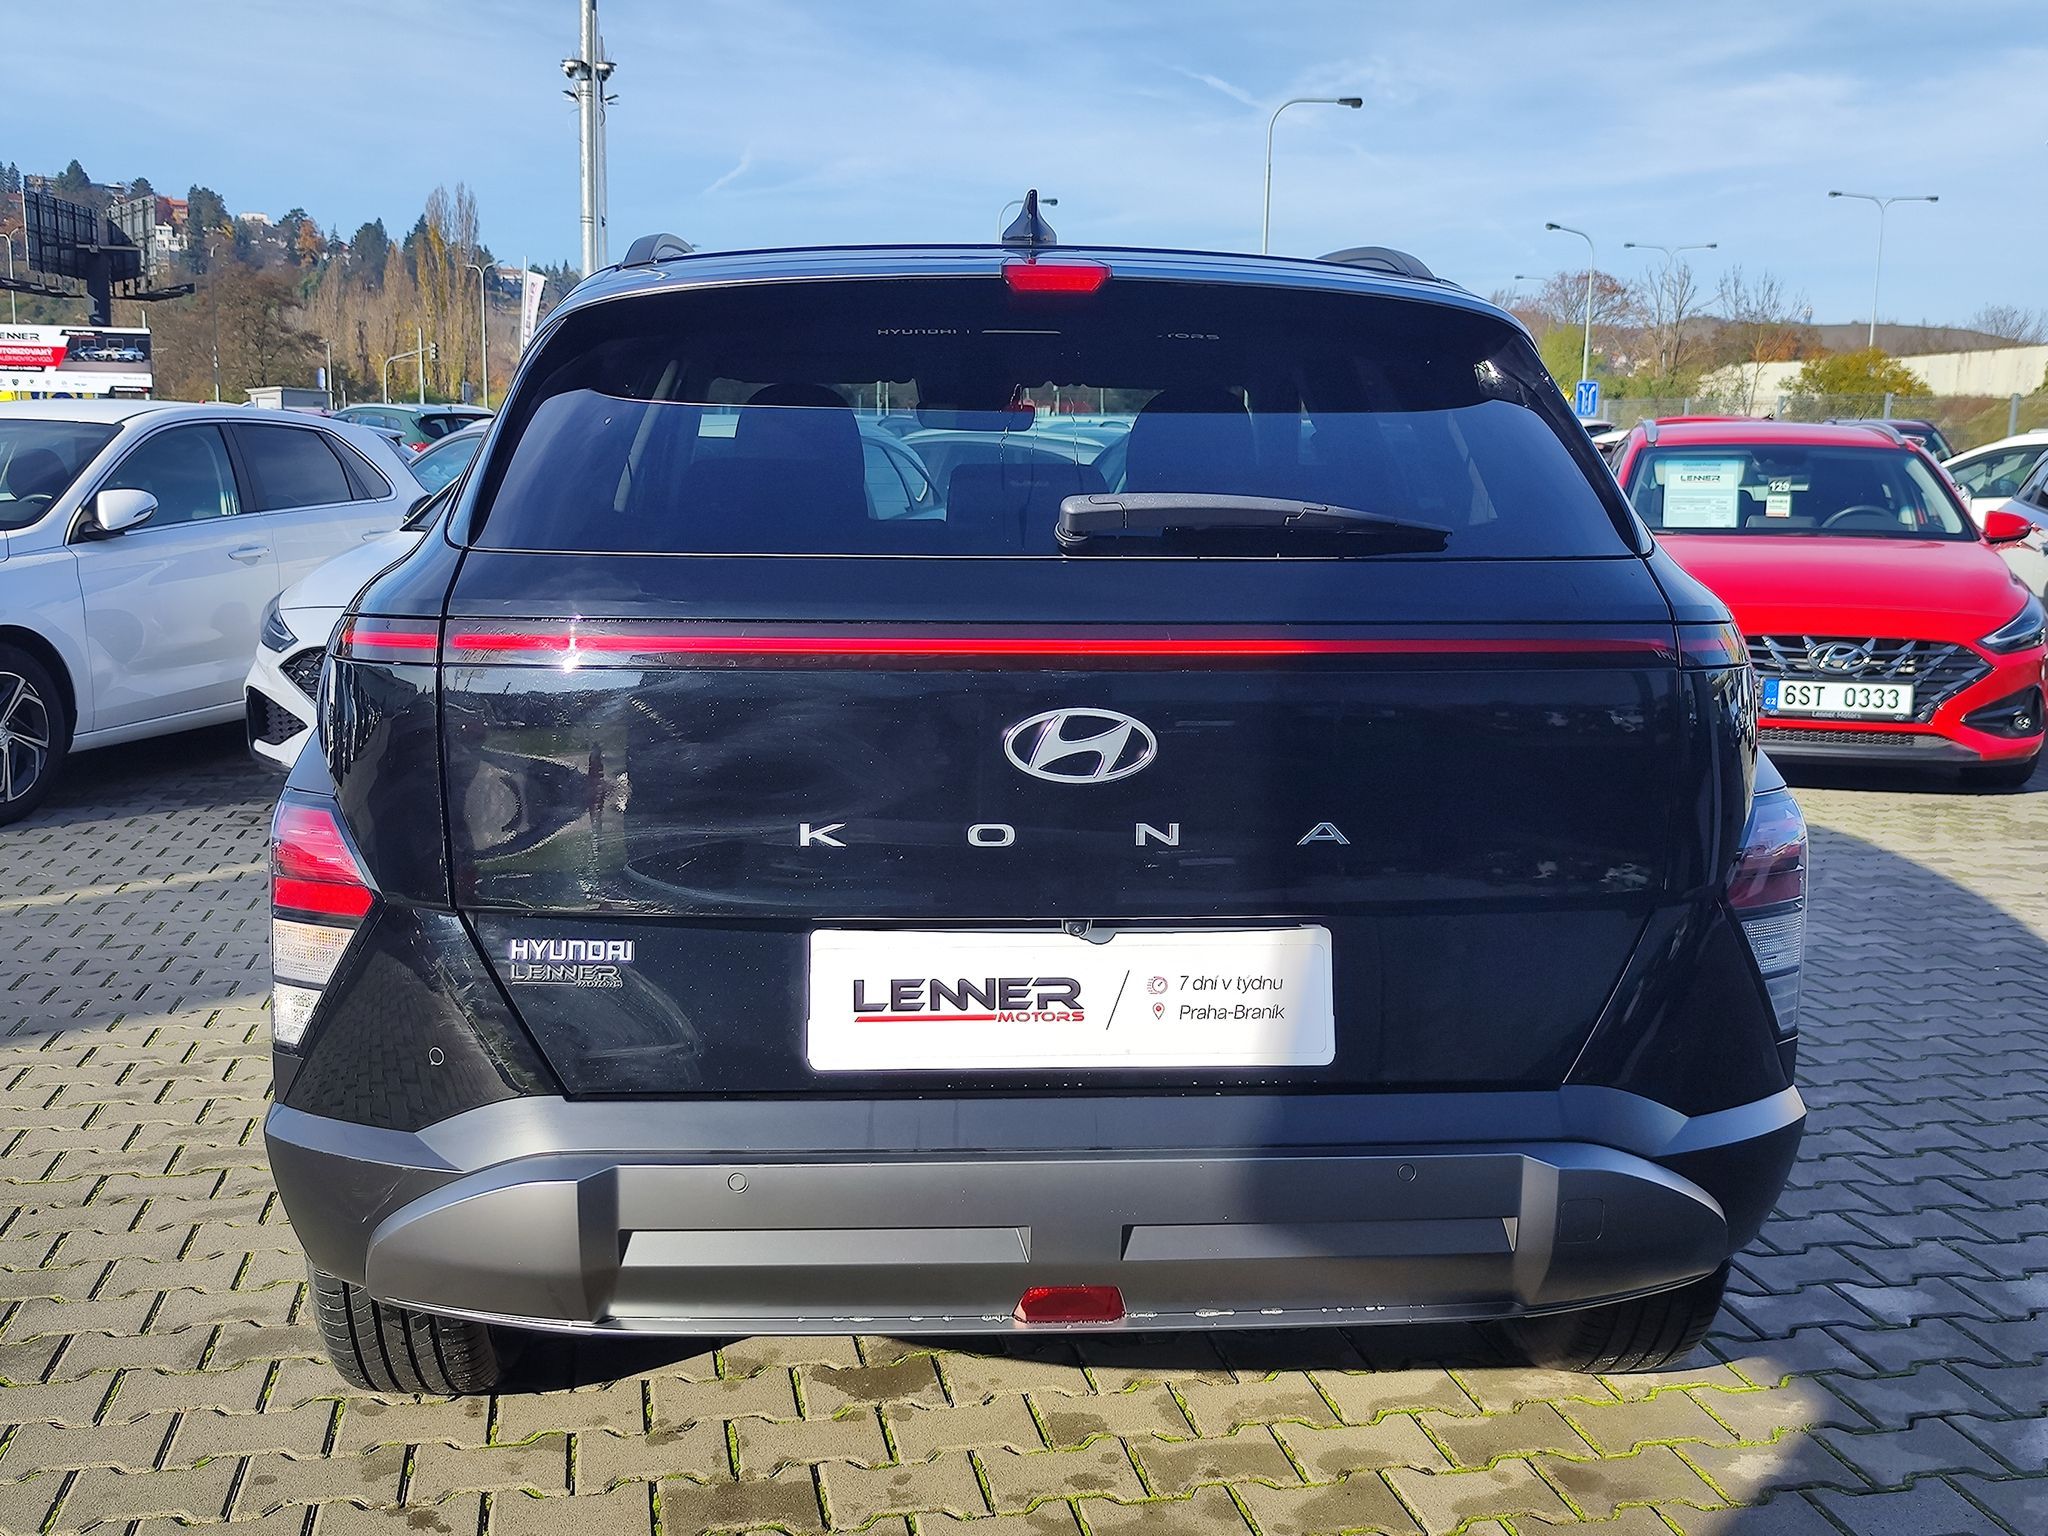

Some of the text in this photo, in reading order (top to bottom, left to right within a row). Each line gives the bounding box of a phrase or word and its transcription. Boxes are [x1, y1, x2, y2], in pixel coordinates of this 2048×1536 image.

[0, 332, 40, 341] ENNER
[1680, 474, 1721, 482] LENNER
[1769, 480, 1790, 492] 129
[1765, 685, 1899, 709] CZ 6ST 0333
[799, 822, 1351, 848] KONA
[511, 939, 636, 962] HYUNDAI
[511, 964, 622, 981] LENNER
[1180, 975, 1284, 994] 7 dní v týdnu
[853, 977, 1085, 1012] LENNER
[997, 1011, 1085, 1023] MOTORS
[1179, 1003, 1286, 1020] Praha-Braník
